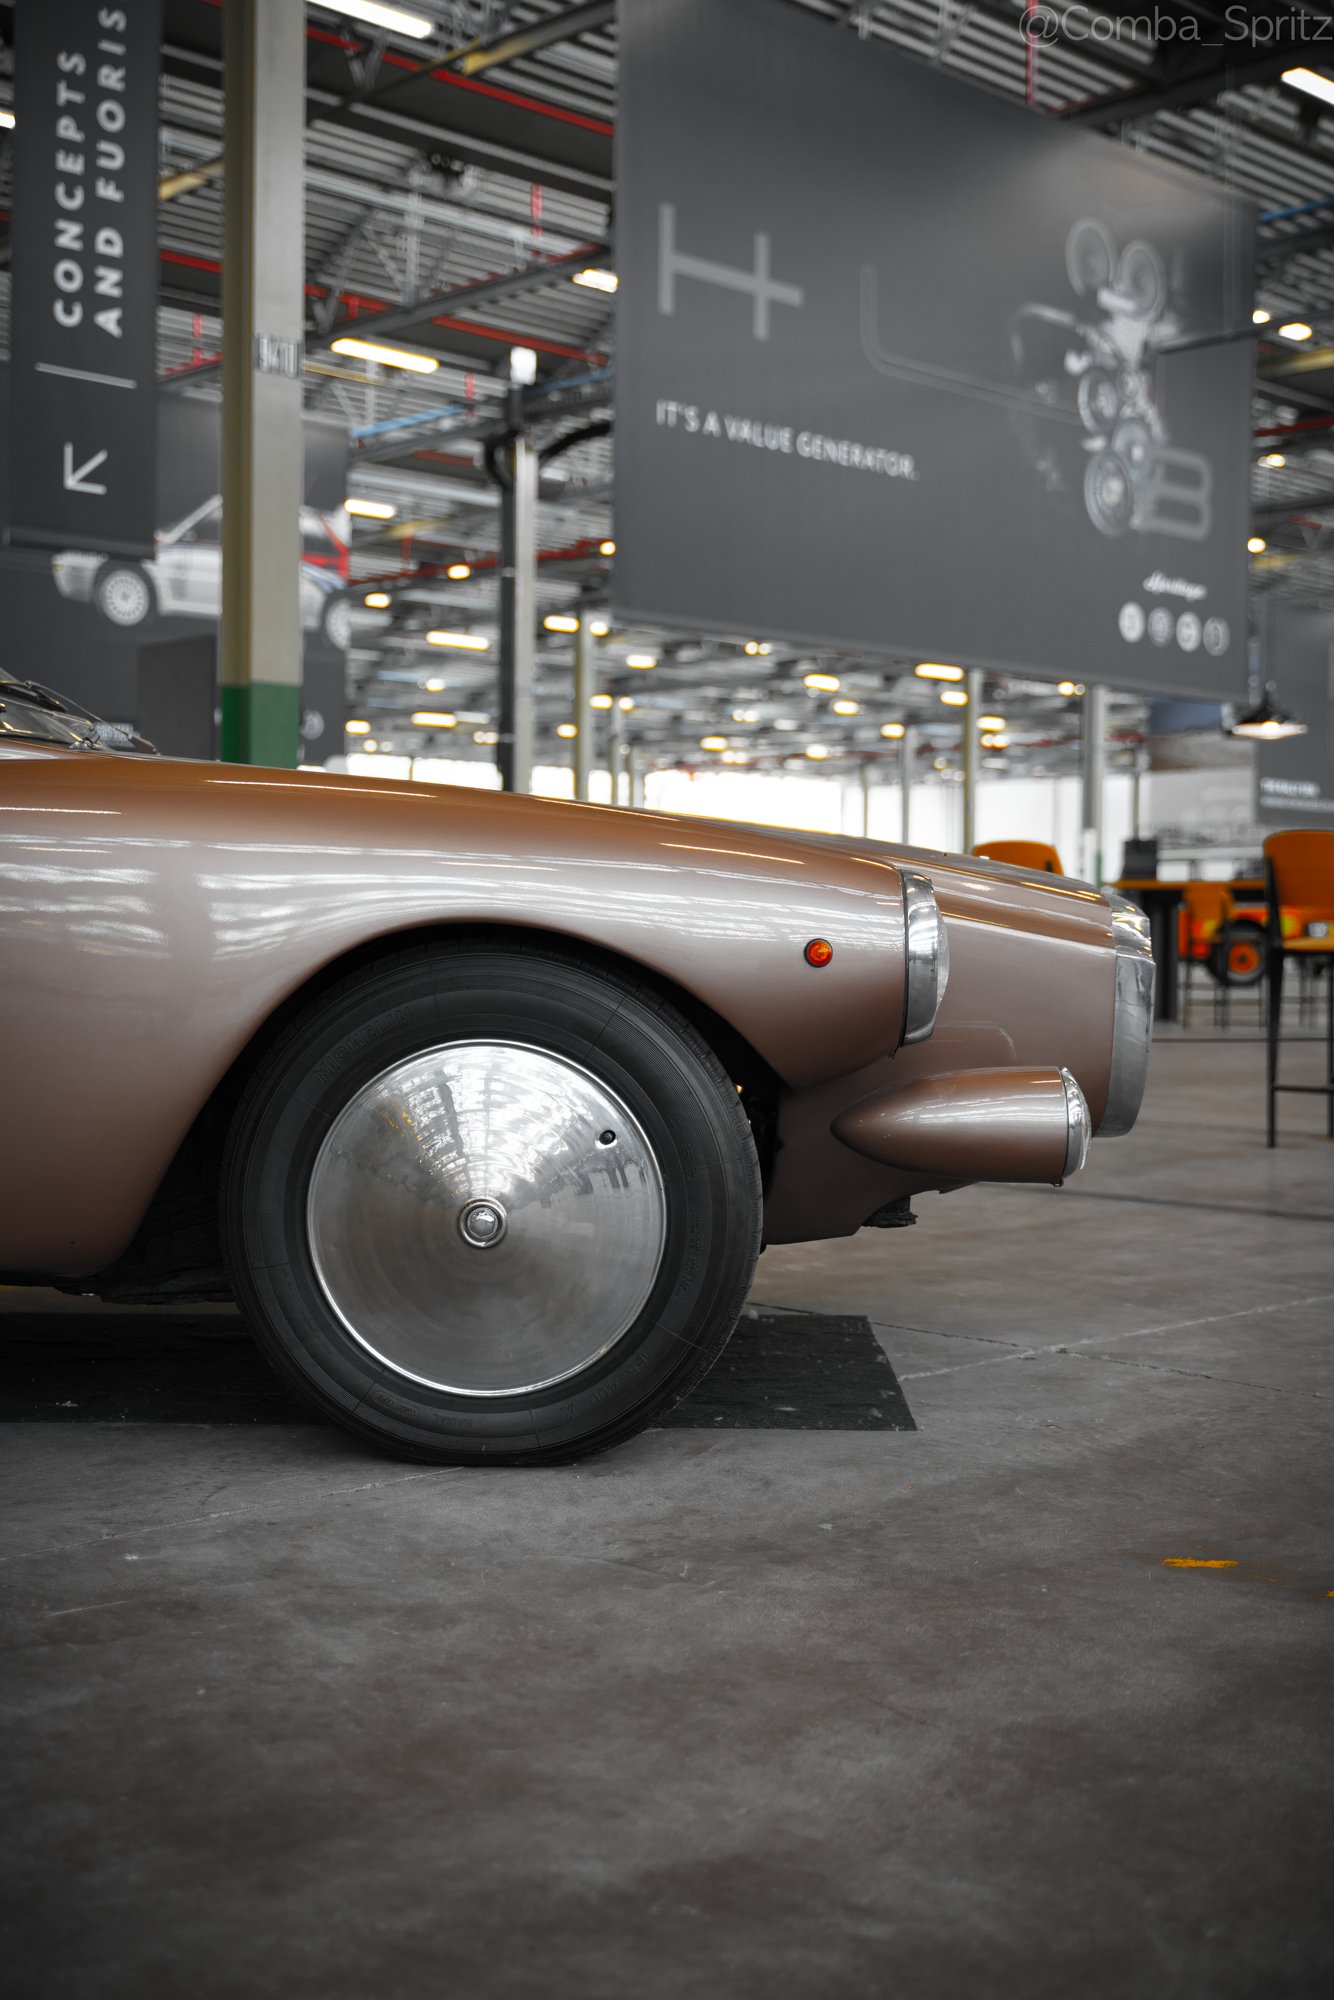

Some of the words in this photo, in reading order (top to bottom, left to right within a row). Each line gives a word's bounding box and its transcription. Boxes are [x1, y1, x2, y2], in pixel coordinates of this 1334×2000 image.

[97, 7, 127, 202] FUORIS
[53, 51, 86, 327] CONCEPTS
[94, 228, 124, 338] AND
[656, 398, 700, 433] IT'S
[703, 411, 722, 438] A
[723, 414, 794, 454] VALUE
[313, 1006, 416, 1082] MICHELIN
